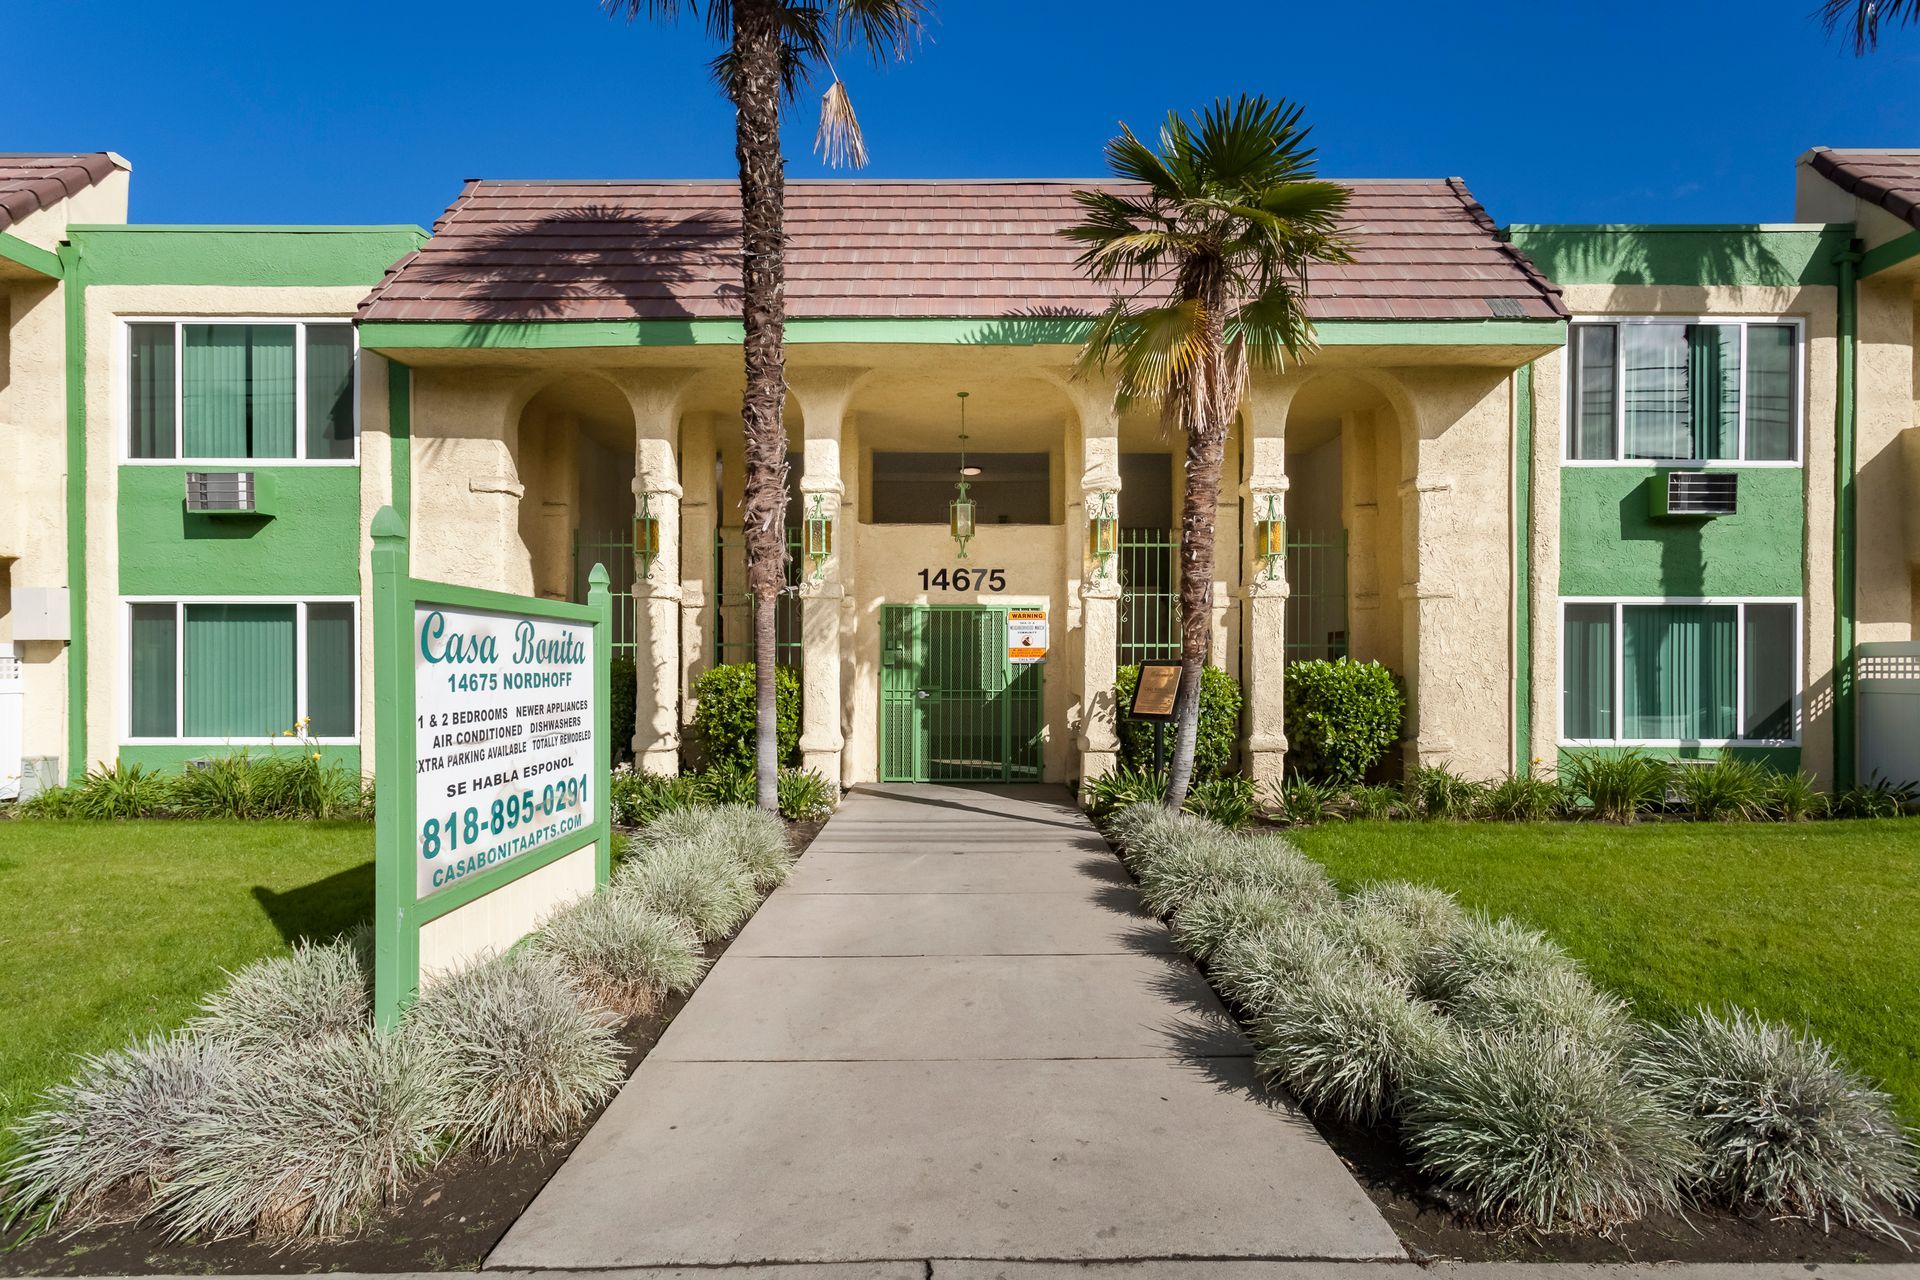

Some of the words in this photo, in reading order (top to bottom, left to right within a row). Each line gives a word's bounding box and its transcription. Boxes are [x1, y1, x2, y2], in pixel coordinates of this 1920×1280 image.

[918, 568, 1006, 592] 14675
[420, 611, 499, 665] Casa
[512, 620, 586, 665] Bonita
[447, 673, 498, 693] 14675
[503, 671, 573, 690] NORDHOFF
[418, 715, 424, 729] 1
[429, 714, 438, 728] &
[442, 712, 449, 727] 2
[452, 707, 509, 726] BEDROOMS
[516, 705, 545, 718] NEWER
[546, 700, 588, 715] APPLIANCES
[433, 734, 453, 749] AIR
[456, 725, 523, 745] CONDITIONED
[530, 716, 581, 734] DISHWASHERS
[447, 749, 486, 768] PARKING
[487, 741, 527, 760] AVAILABLE
[532, 736, 559, 752] TOTALLY
[560, 730, 592, 746] REMODELED
[446, 782, 467, 798] SE
[472, 770, 519, 791] HABLA
[523, 757, 574, 779] ESPONOL
[422, 774, 588, 860] 818-895-0291
[433, 814, 582, 887] CASABONITAAPTS.COM
